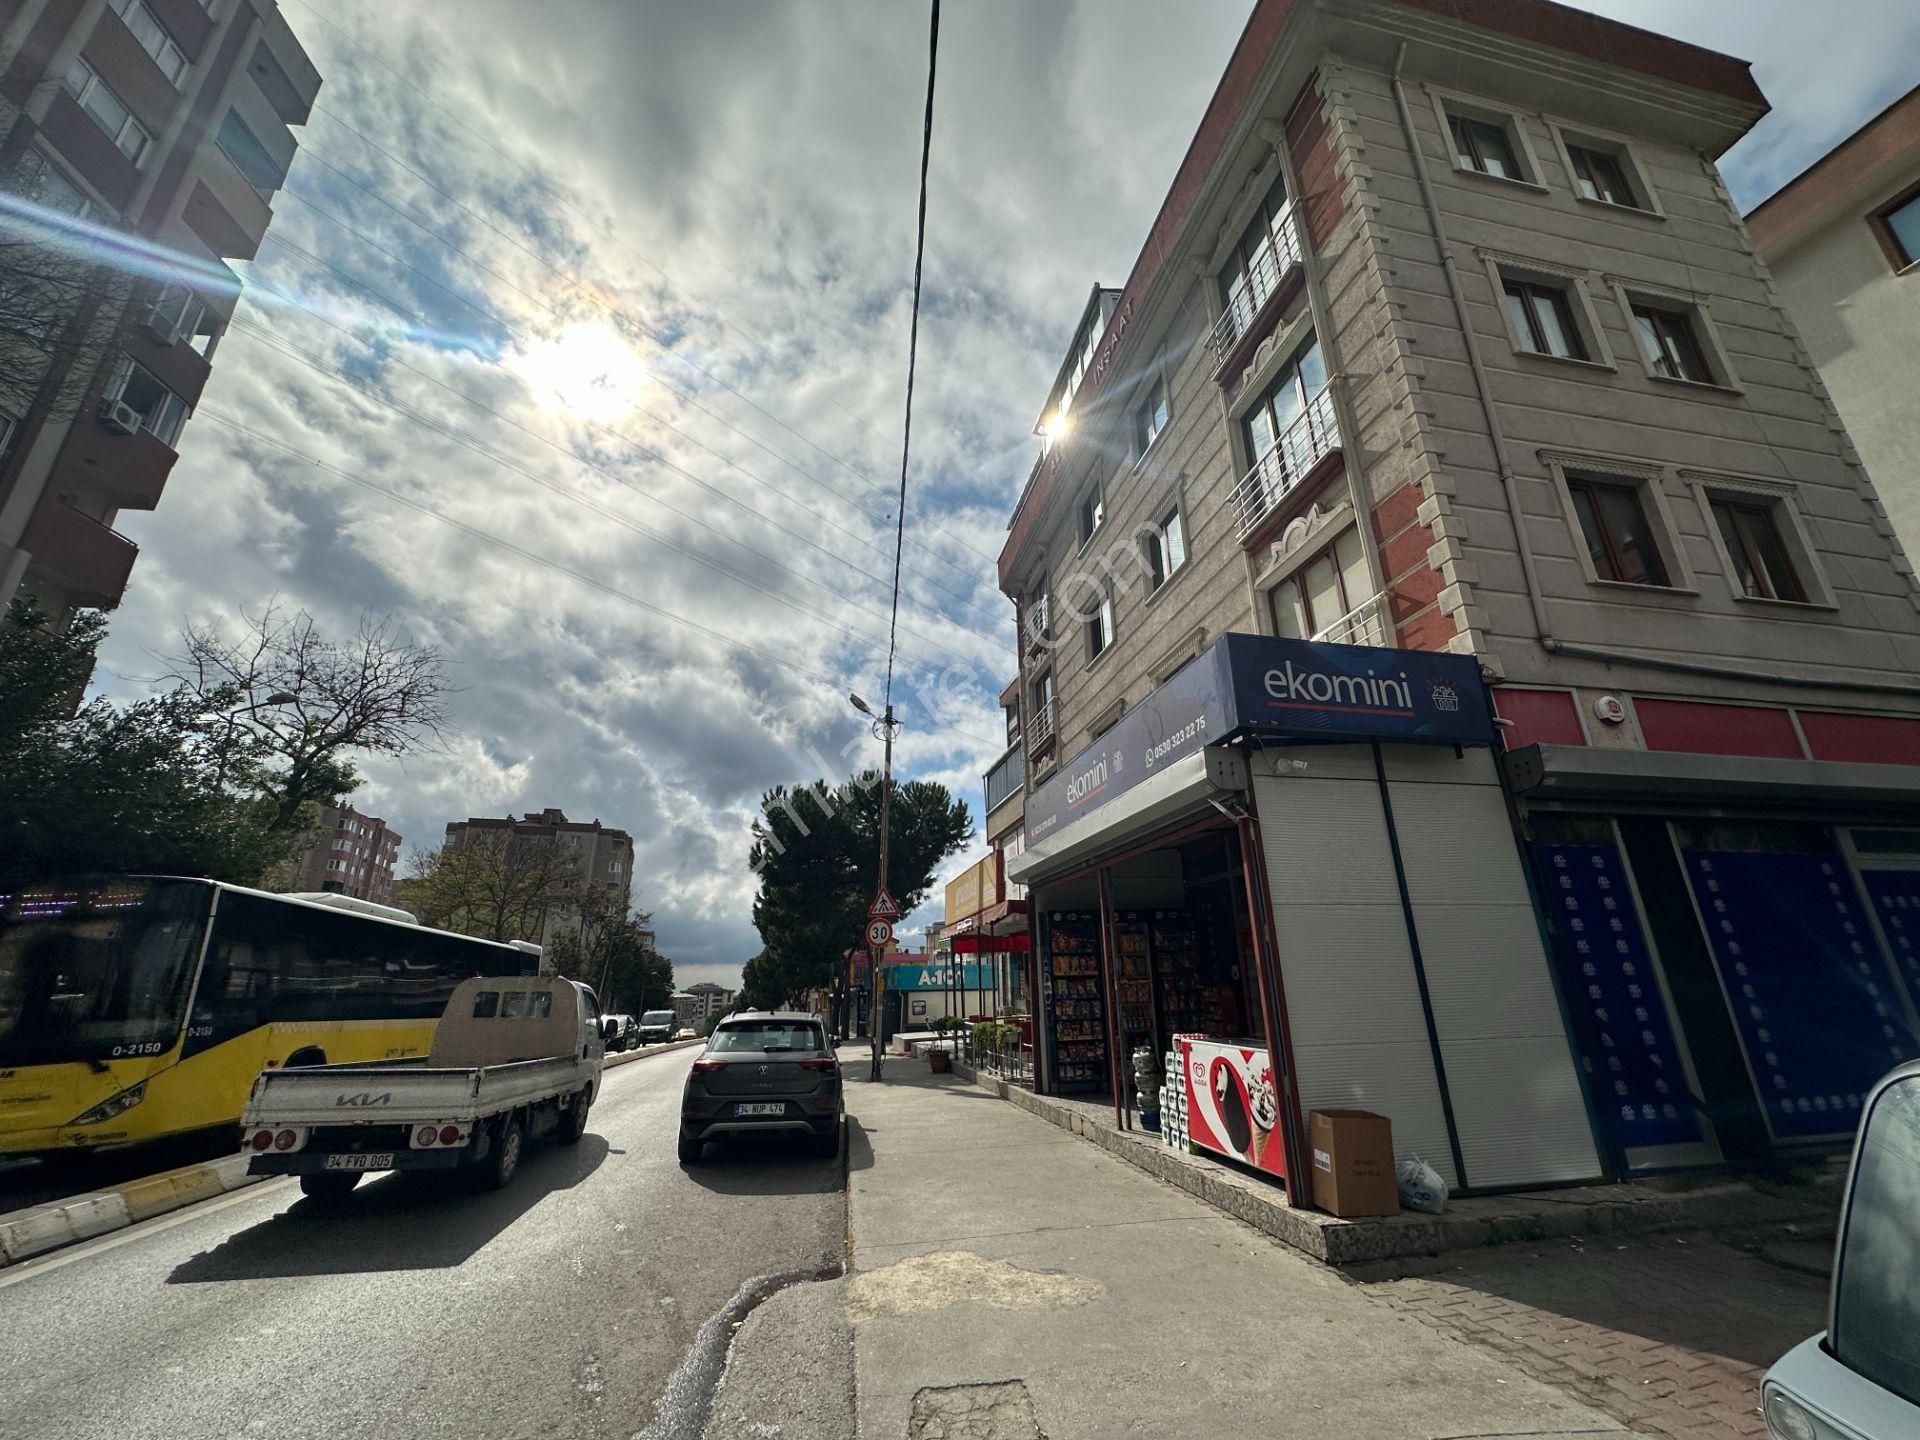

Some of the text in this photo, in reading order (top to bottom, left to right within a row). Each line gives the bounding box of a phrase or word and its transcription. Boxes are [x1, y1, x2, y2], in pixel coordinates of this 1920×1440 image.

[1264, 661, 1413, 709] ekomini
[1154, 715, 1206, 759] 0530 323 22 75
[1066, 752, 1109, 804] ekomini
[872, 926, 887, 939] 30
[336, 1092, 392, 1106] KIA
[740, 1104, 783, 1113] 34 NUP 474
[329, 1155, 341, 1168] 34
[370, 1154, 391, 1167] 005
